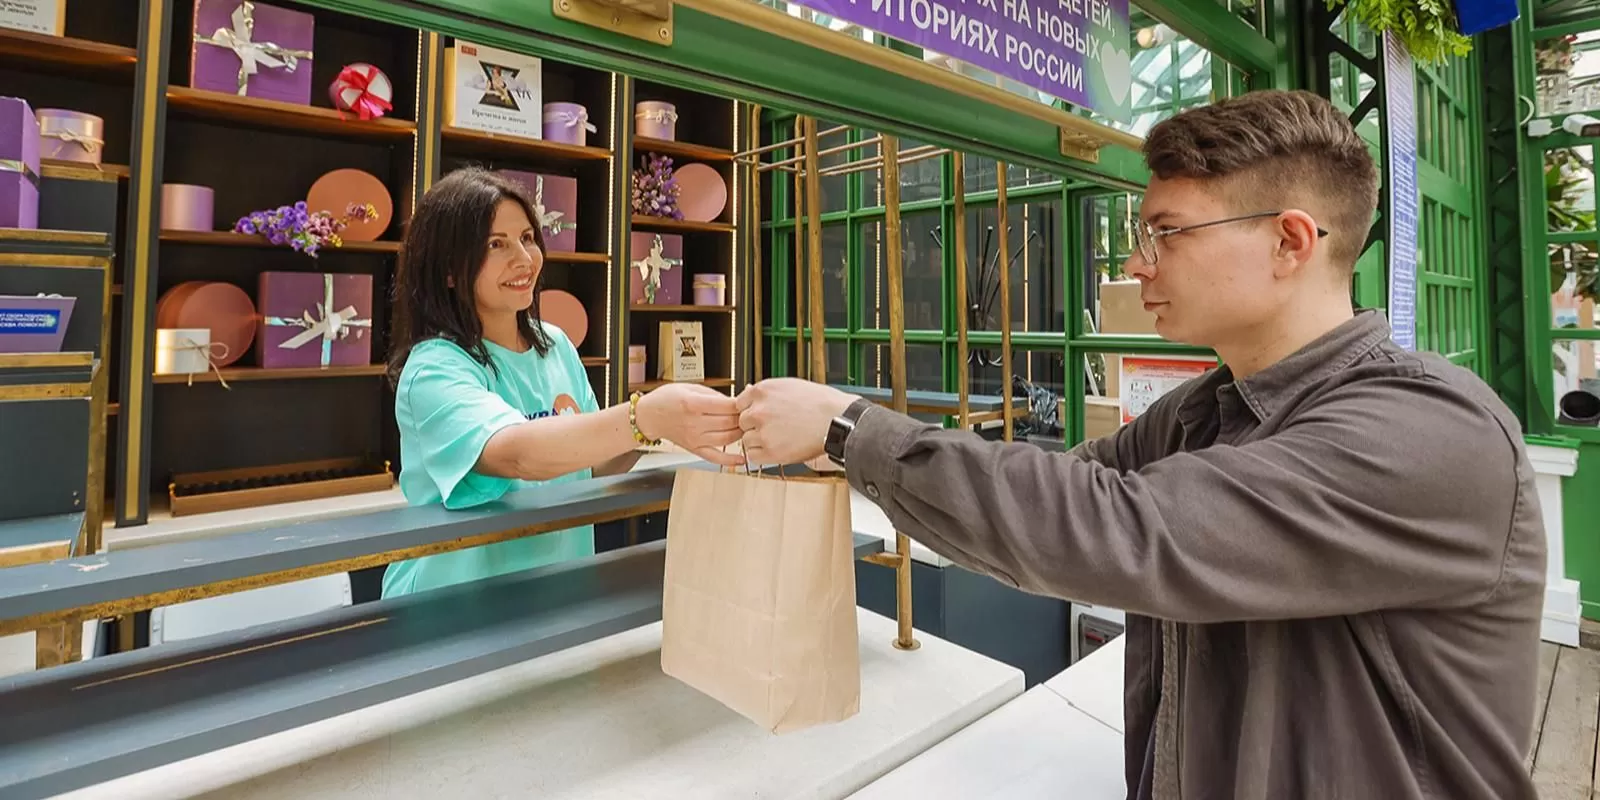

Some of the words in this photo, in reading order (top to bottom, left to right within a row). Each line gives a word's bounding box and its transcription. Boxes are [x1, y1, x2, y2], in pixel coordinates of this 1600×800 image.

[850, 0, 999, 58] ТОРИЯХ
[1005, 34, 1083, 92] РОССИИ
[1003, 0, 1032, 29] НА
[1037, 7, 1100, 63] НОВЫХ
